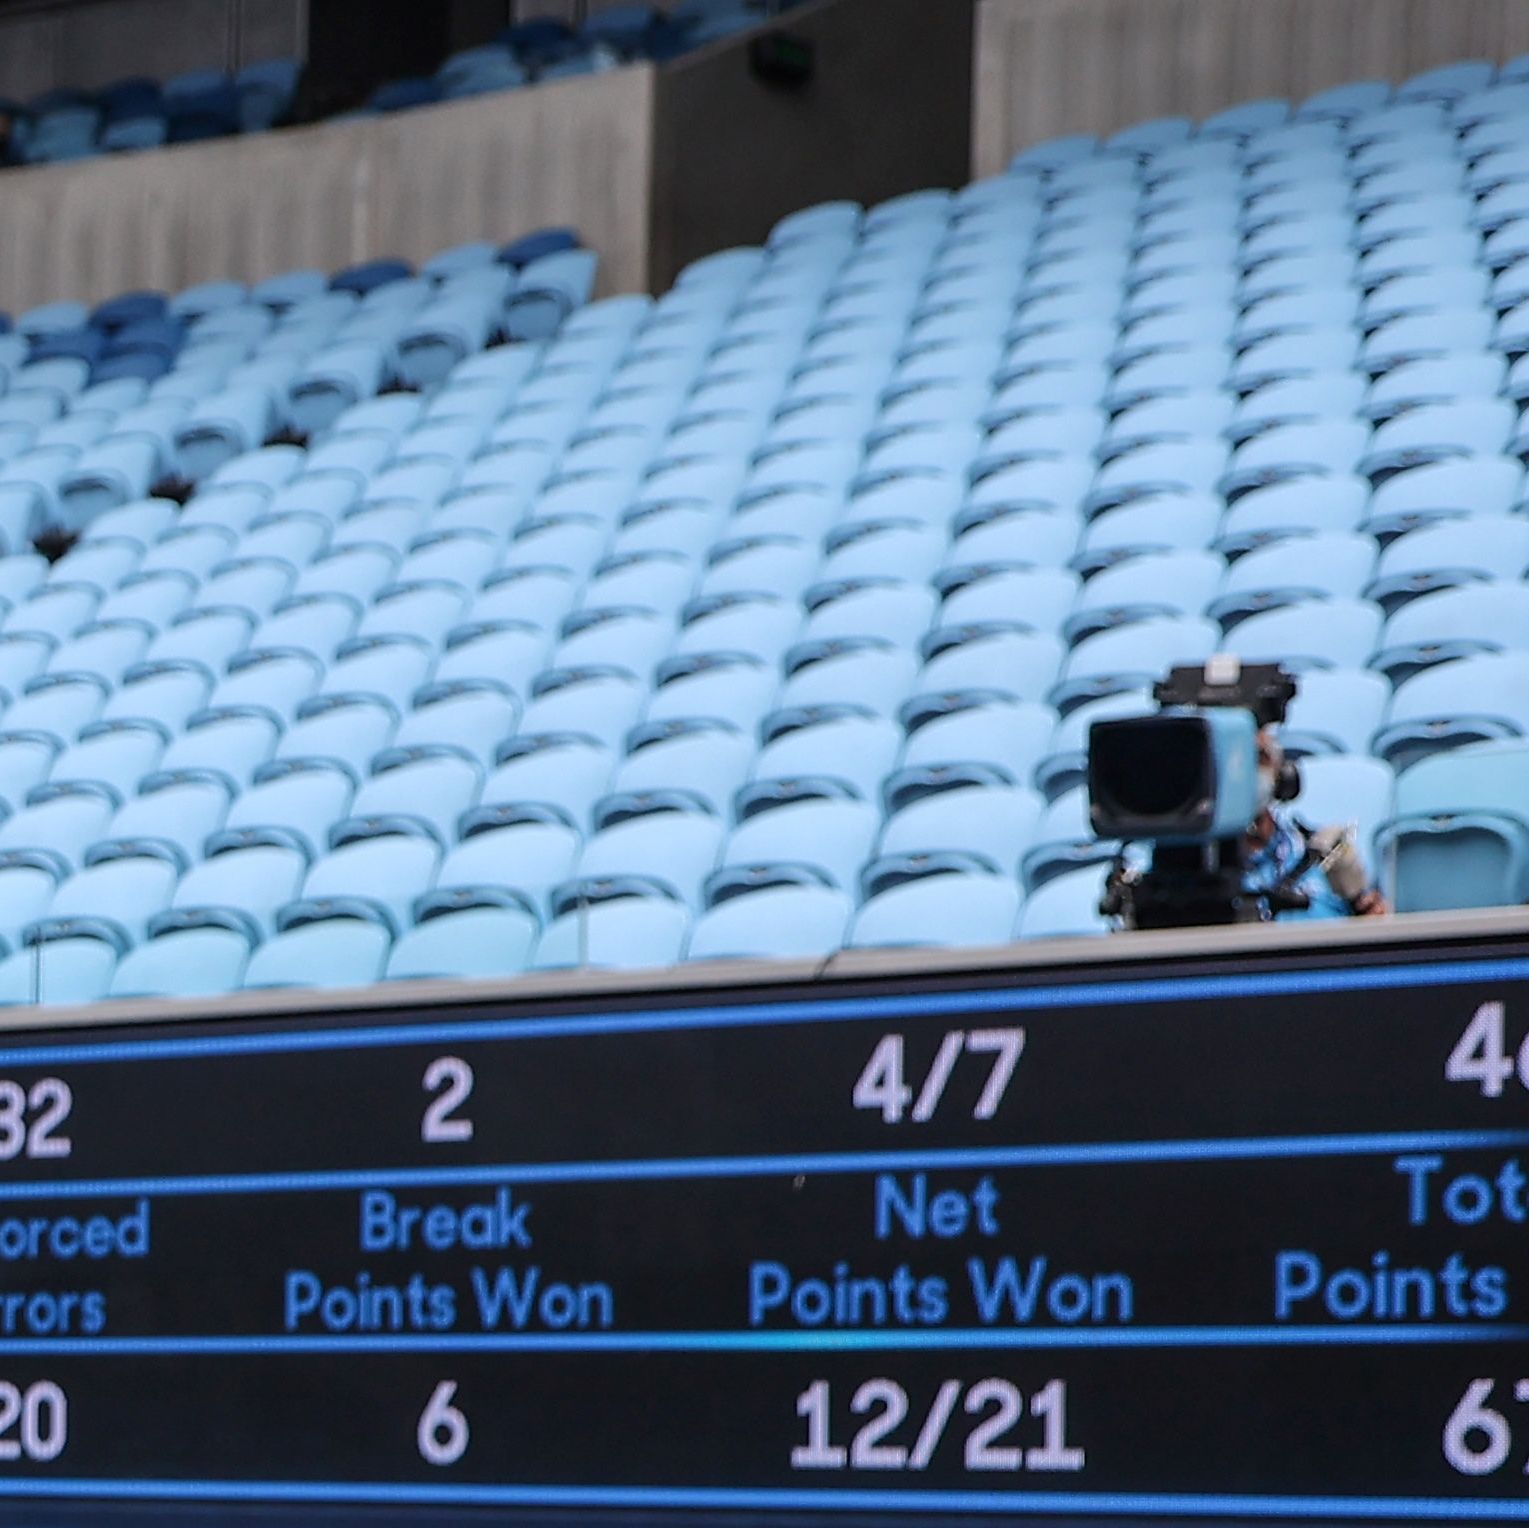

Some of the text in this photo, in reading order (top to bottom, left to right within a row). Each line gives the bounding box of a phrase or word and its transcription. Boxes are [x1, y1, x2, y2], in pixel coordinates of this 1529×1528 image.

[852, 1027, 1026, 1124] 4/7
[1445, 1001, 1529, 1098] 4
[421, 1055, 474, 1143] 2
[360, 1186, 533, 1252] Break
[874, 1172, 1000, 1239] Net
[1393, 1154, 1529, 1226] Tot
[283, 1265, 614, 1332] Points Won
[748, 1256, 1134, 1326] Points Won
[1273, 1249, 1508, 1320] Points
[416, 1379, 470, 1465] 6
[790, 1376, 1086, 1471] 12/21
[1444, 1378, 1529, 1476] 6
